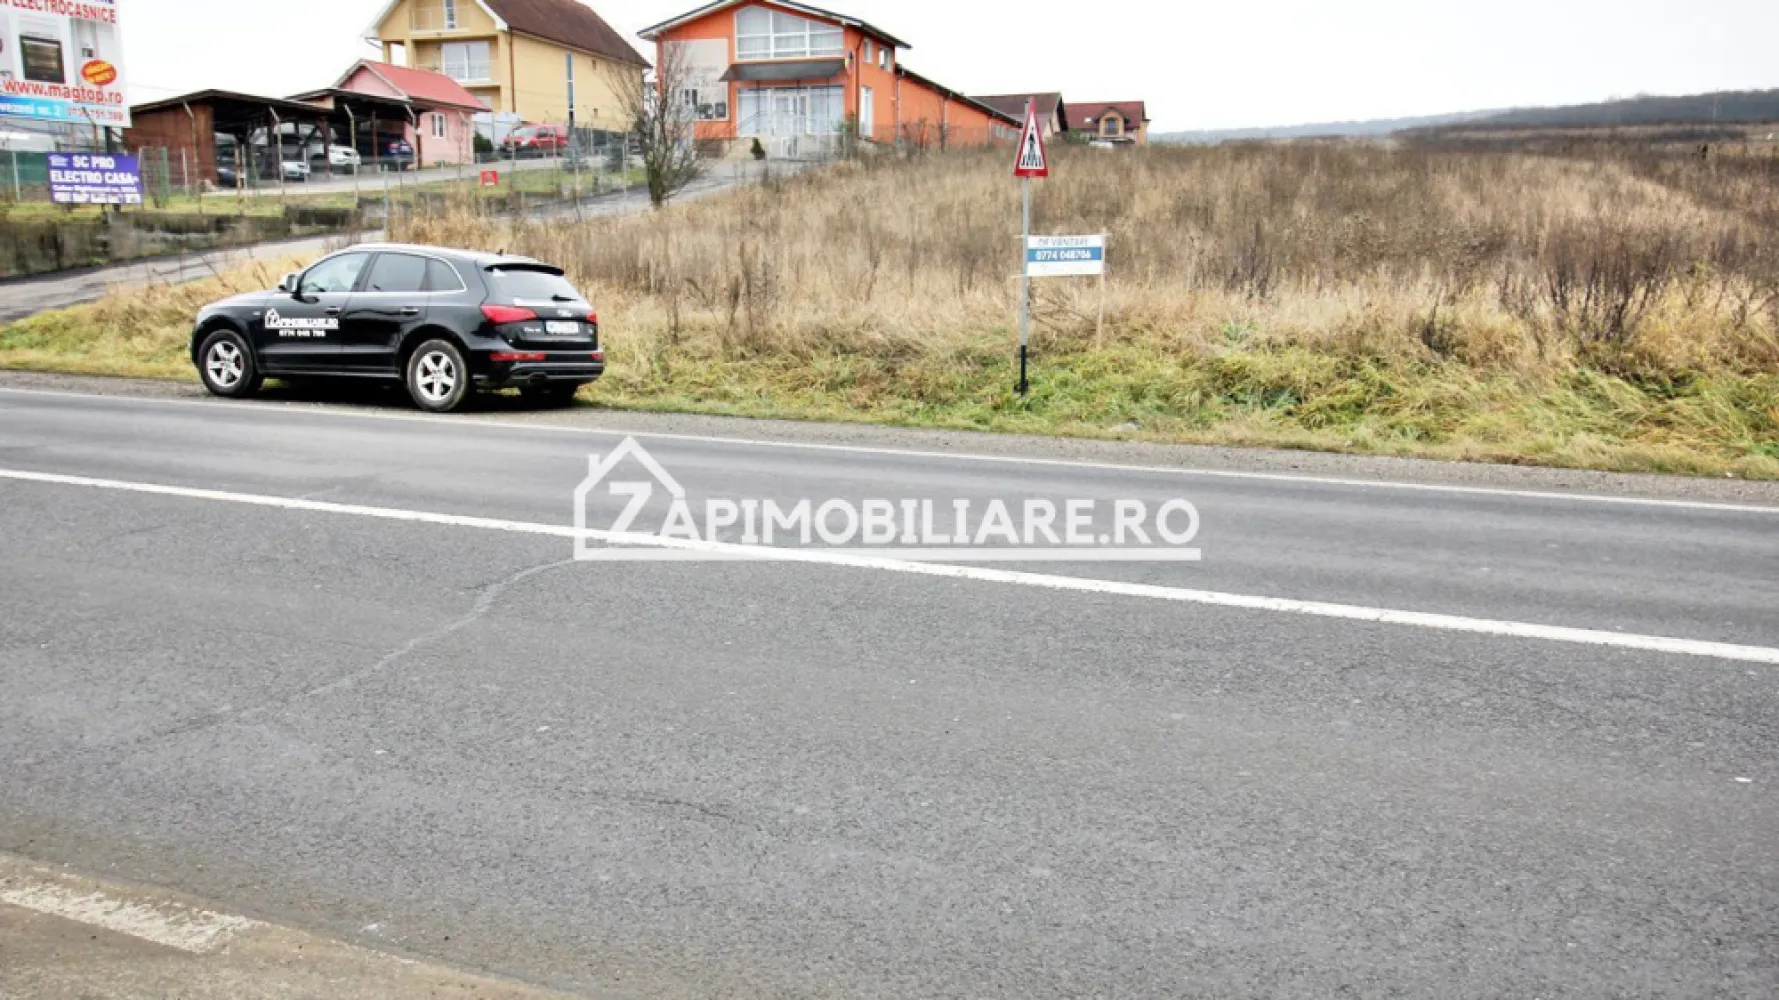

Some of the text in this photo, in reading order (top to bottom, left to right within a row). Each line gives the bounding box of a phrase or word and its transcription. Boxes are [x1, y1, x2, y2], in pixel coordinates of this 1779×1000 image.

[3, 80, 123, 104] www.magtop.ro
[72, 155, 90, 168] SC
[91, 156, 115, 169] PRO
[50, 170, 102, 184] ELECTRO
